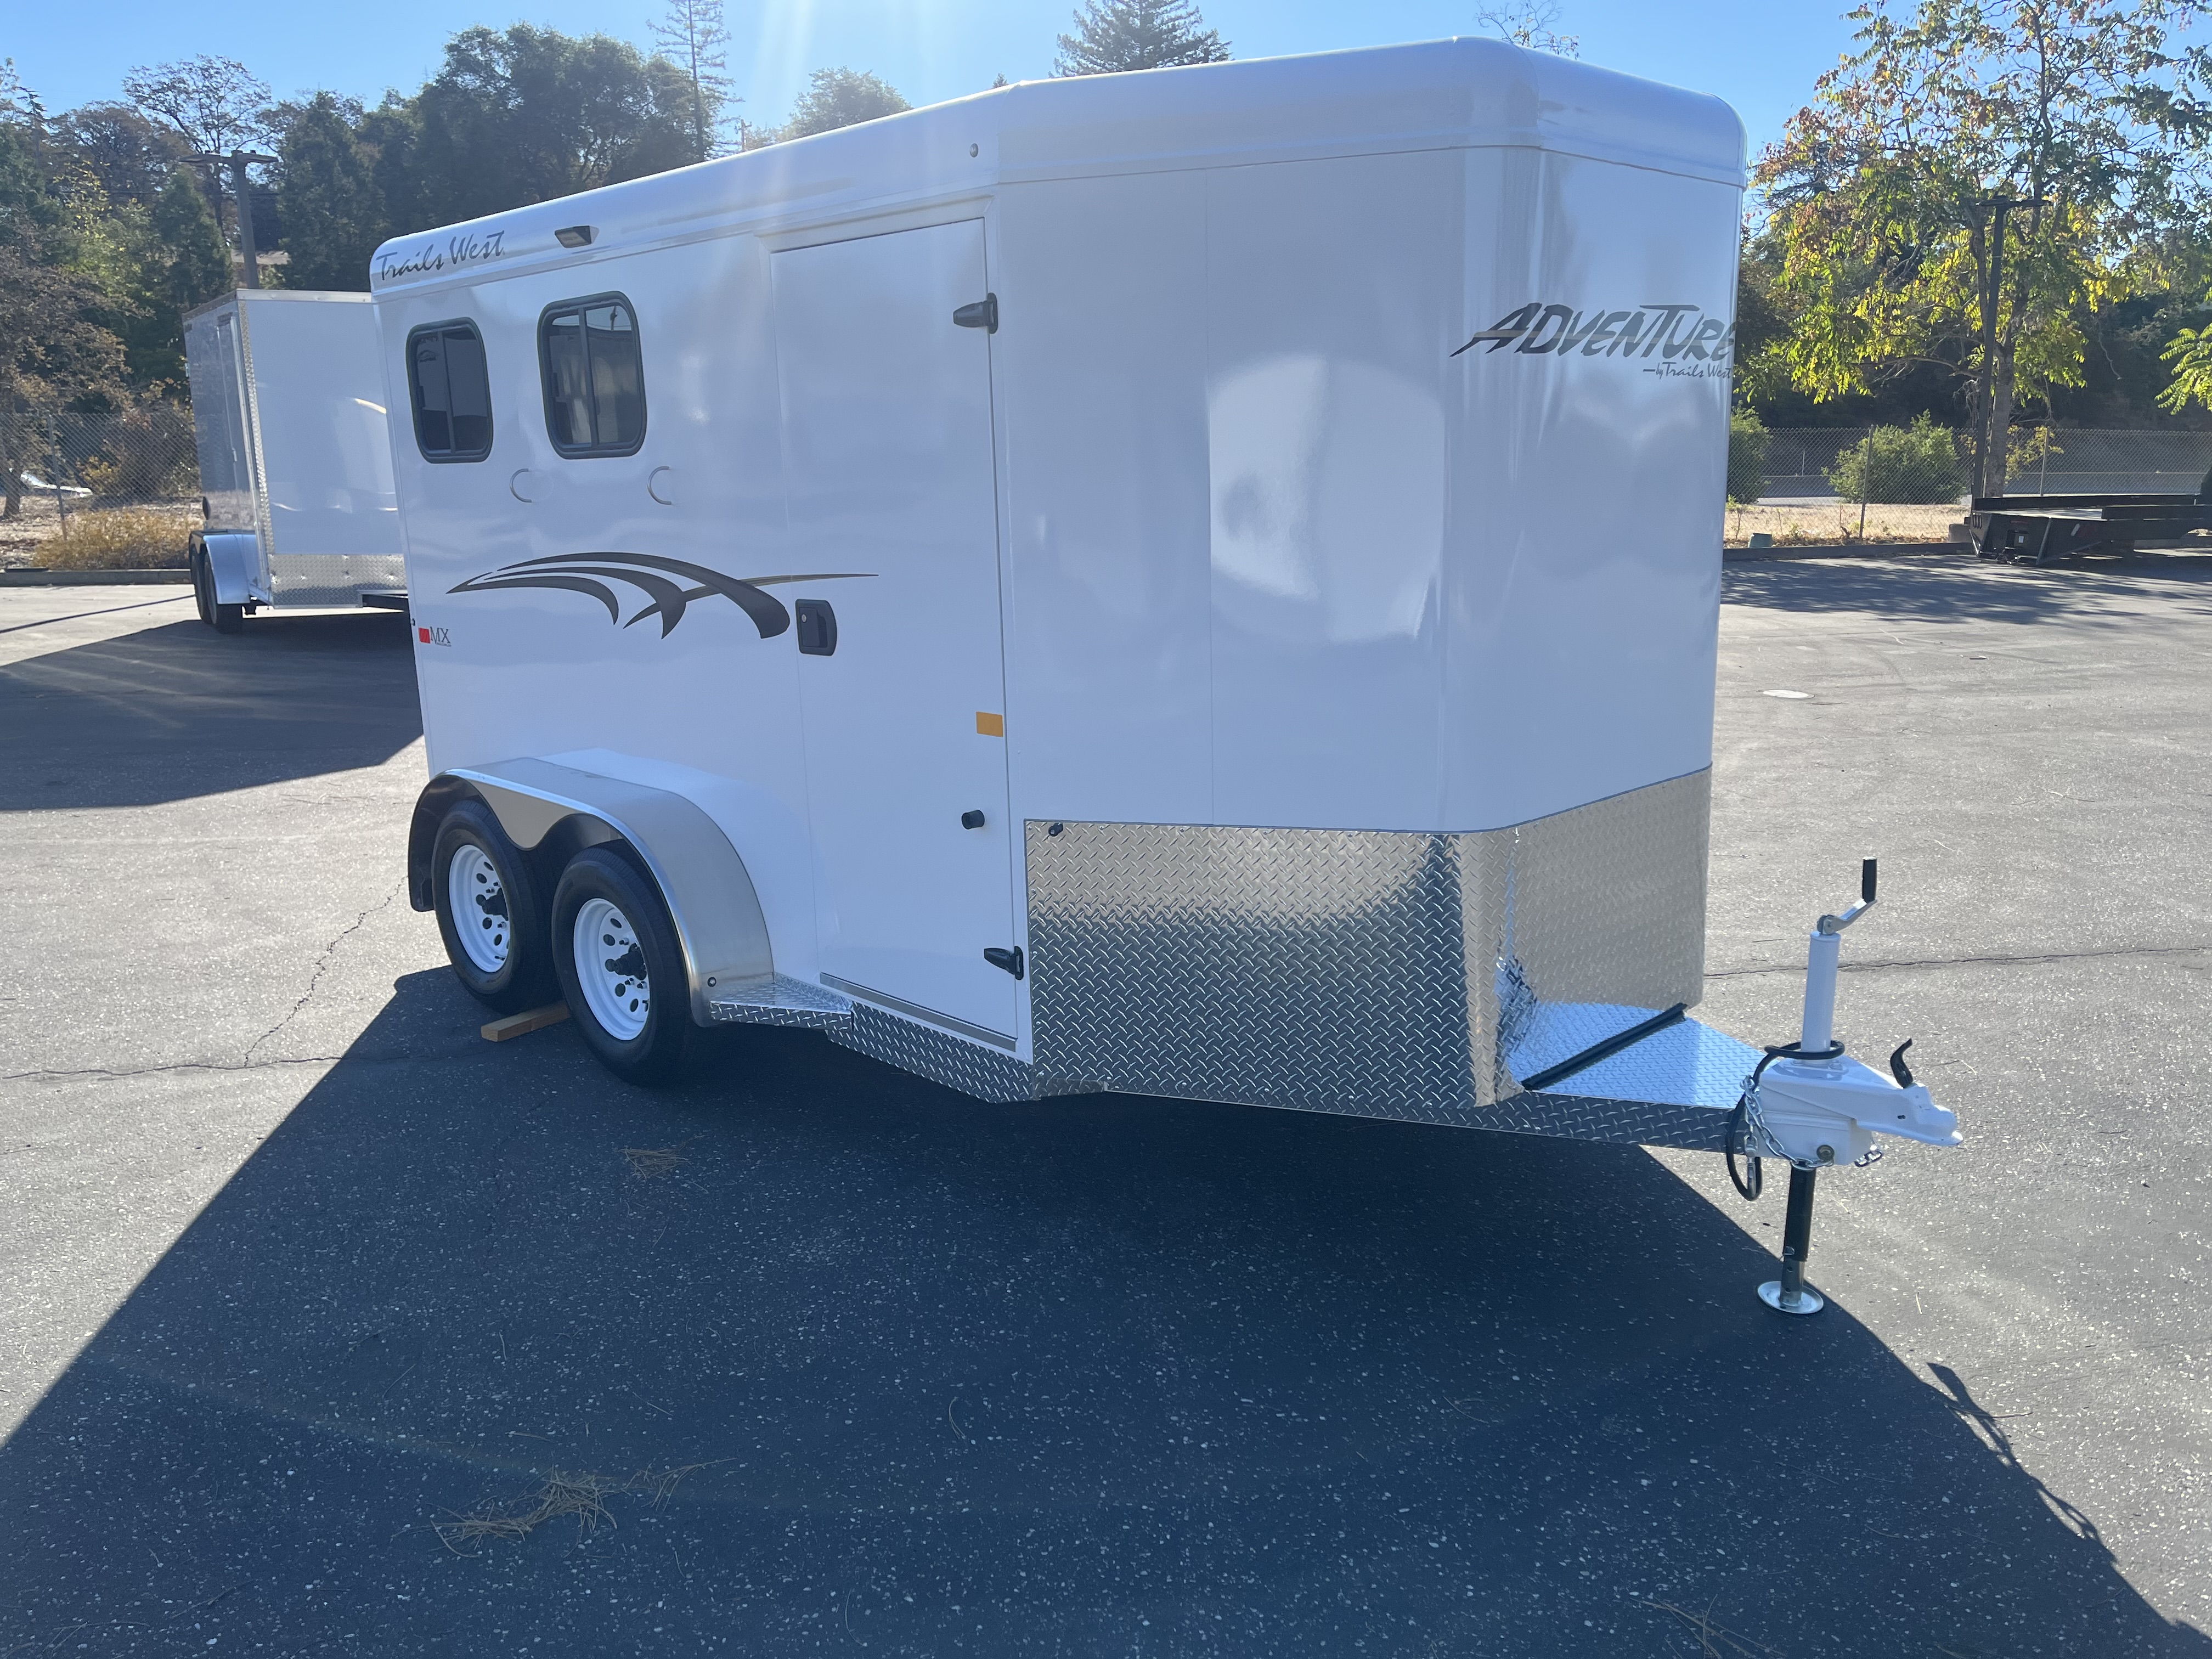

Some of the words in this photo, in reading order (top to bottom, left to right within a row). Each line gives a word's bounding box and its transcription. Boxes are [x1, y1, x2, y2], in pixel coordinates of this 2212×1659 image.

[376, 244, 444, 280] Trails
[449, 230, 505, 264] West
[1449, 302, 1737, 362] ADVENTURE
[1662, 362, 1704, 378] Trails
[1707, 363, 1731, 379] West
[430, 626, 450, 644] MX
